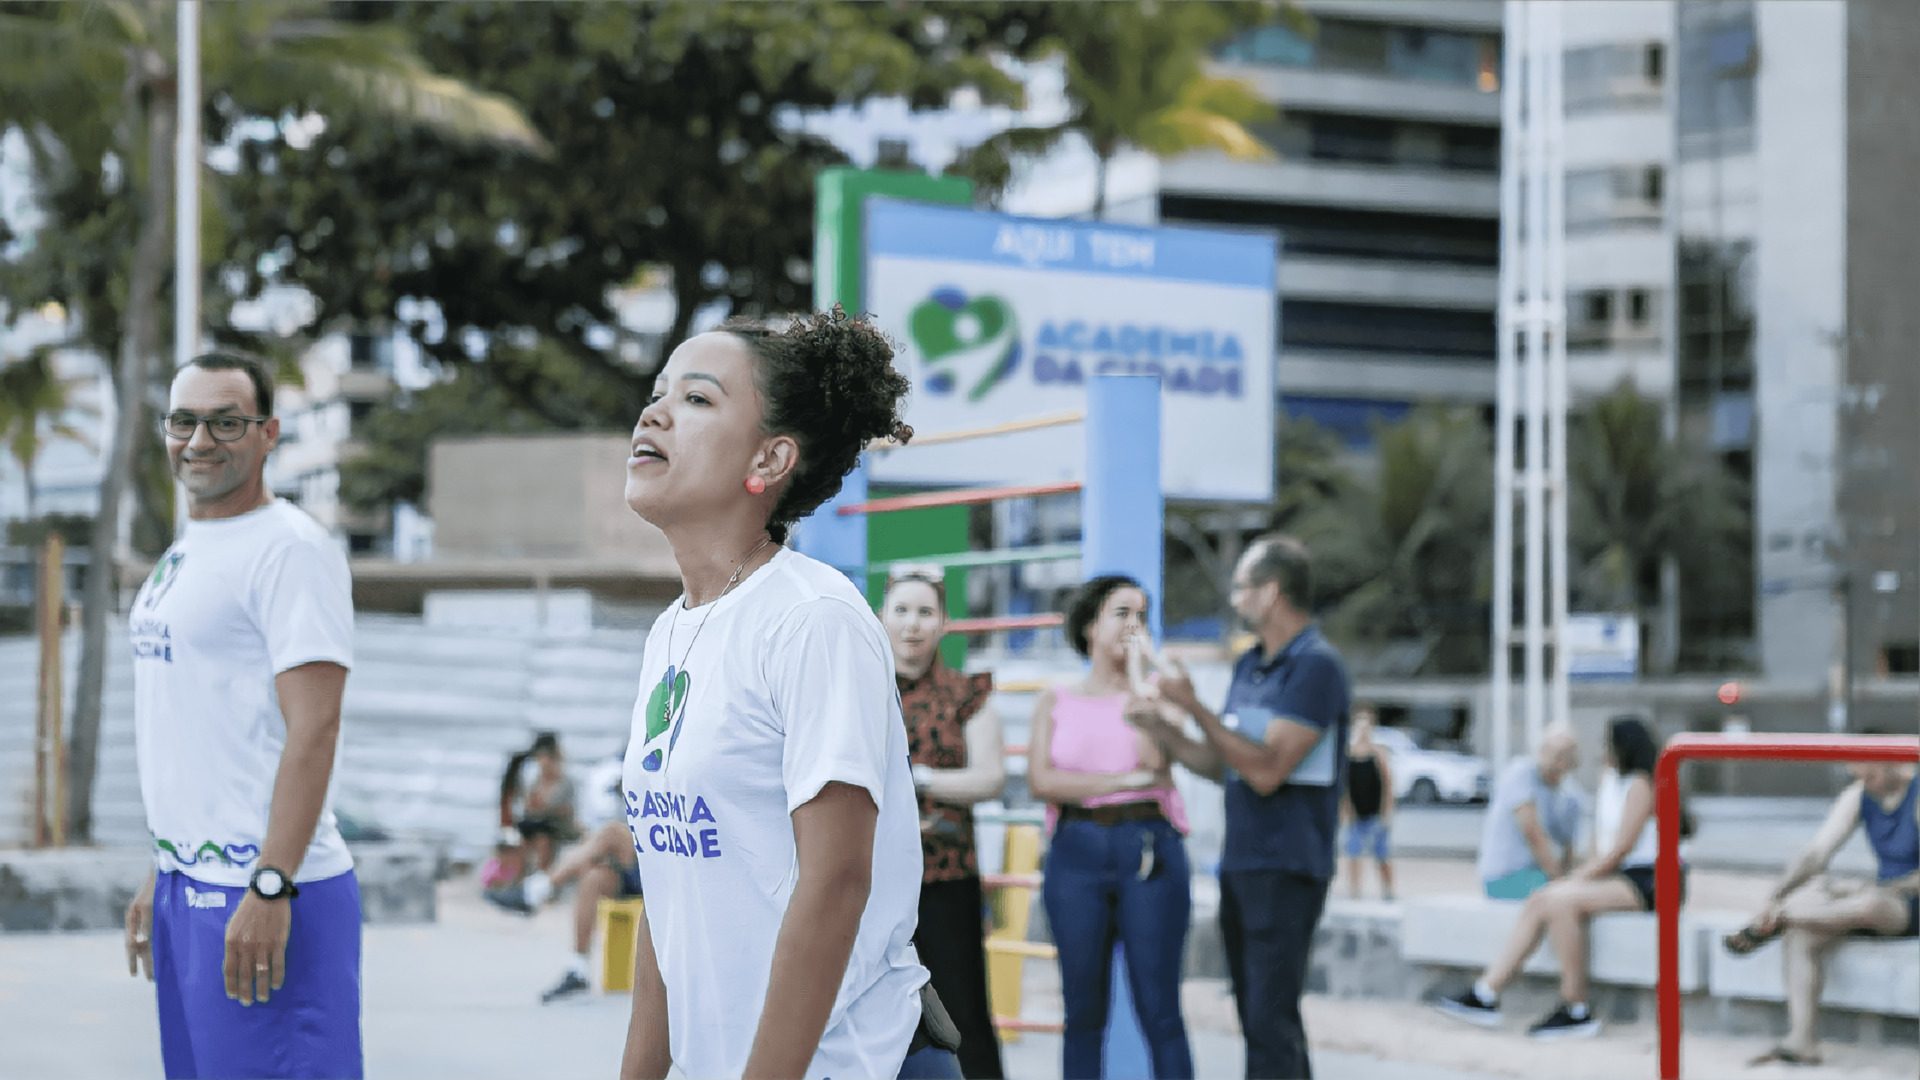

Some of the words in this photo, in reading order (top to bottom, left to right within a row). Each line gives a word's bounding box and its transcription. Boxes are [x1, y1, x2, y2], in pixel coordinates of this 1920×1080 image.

[992, 223, 1075, 268] AQUI
[1089, 231, 1155, 267] TEM
[1037, 319, 1243, 361] ACADEMIA
[1034, 355, 1083, 385] DA
[649, 824, 722, 858] CIADE
